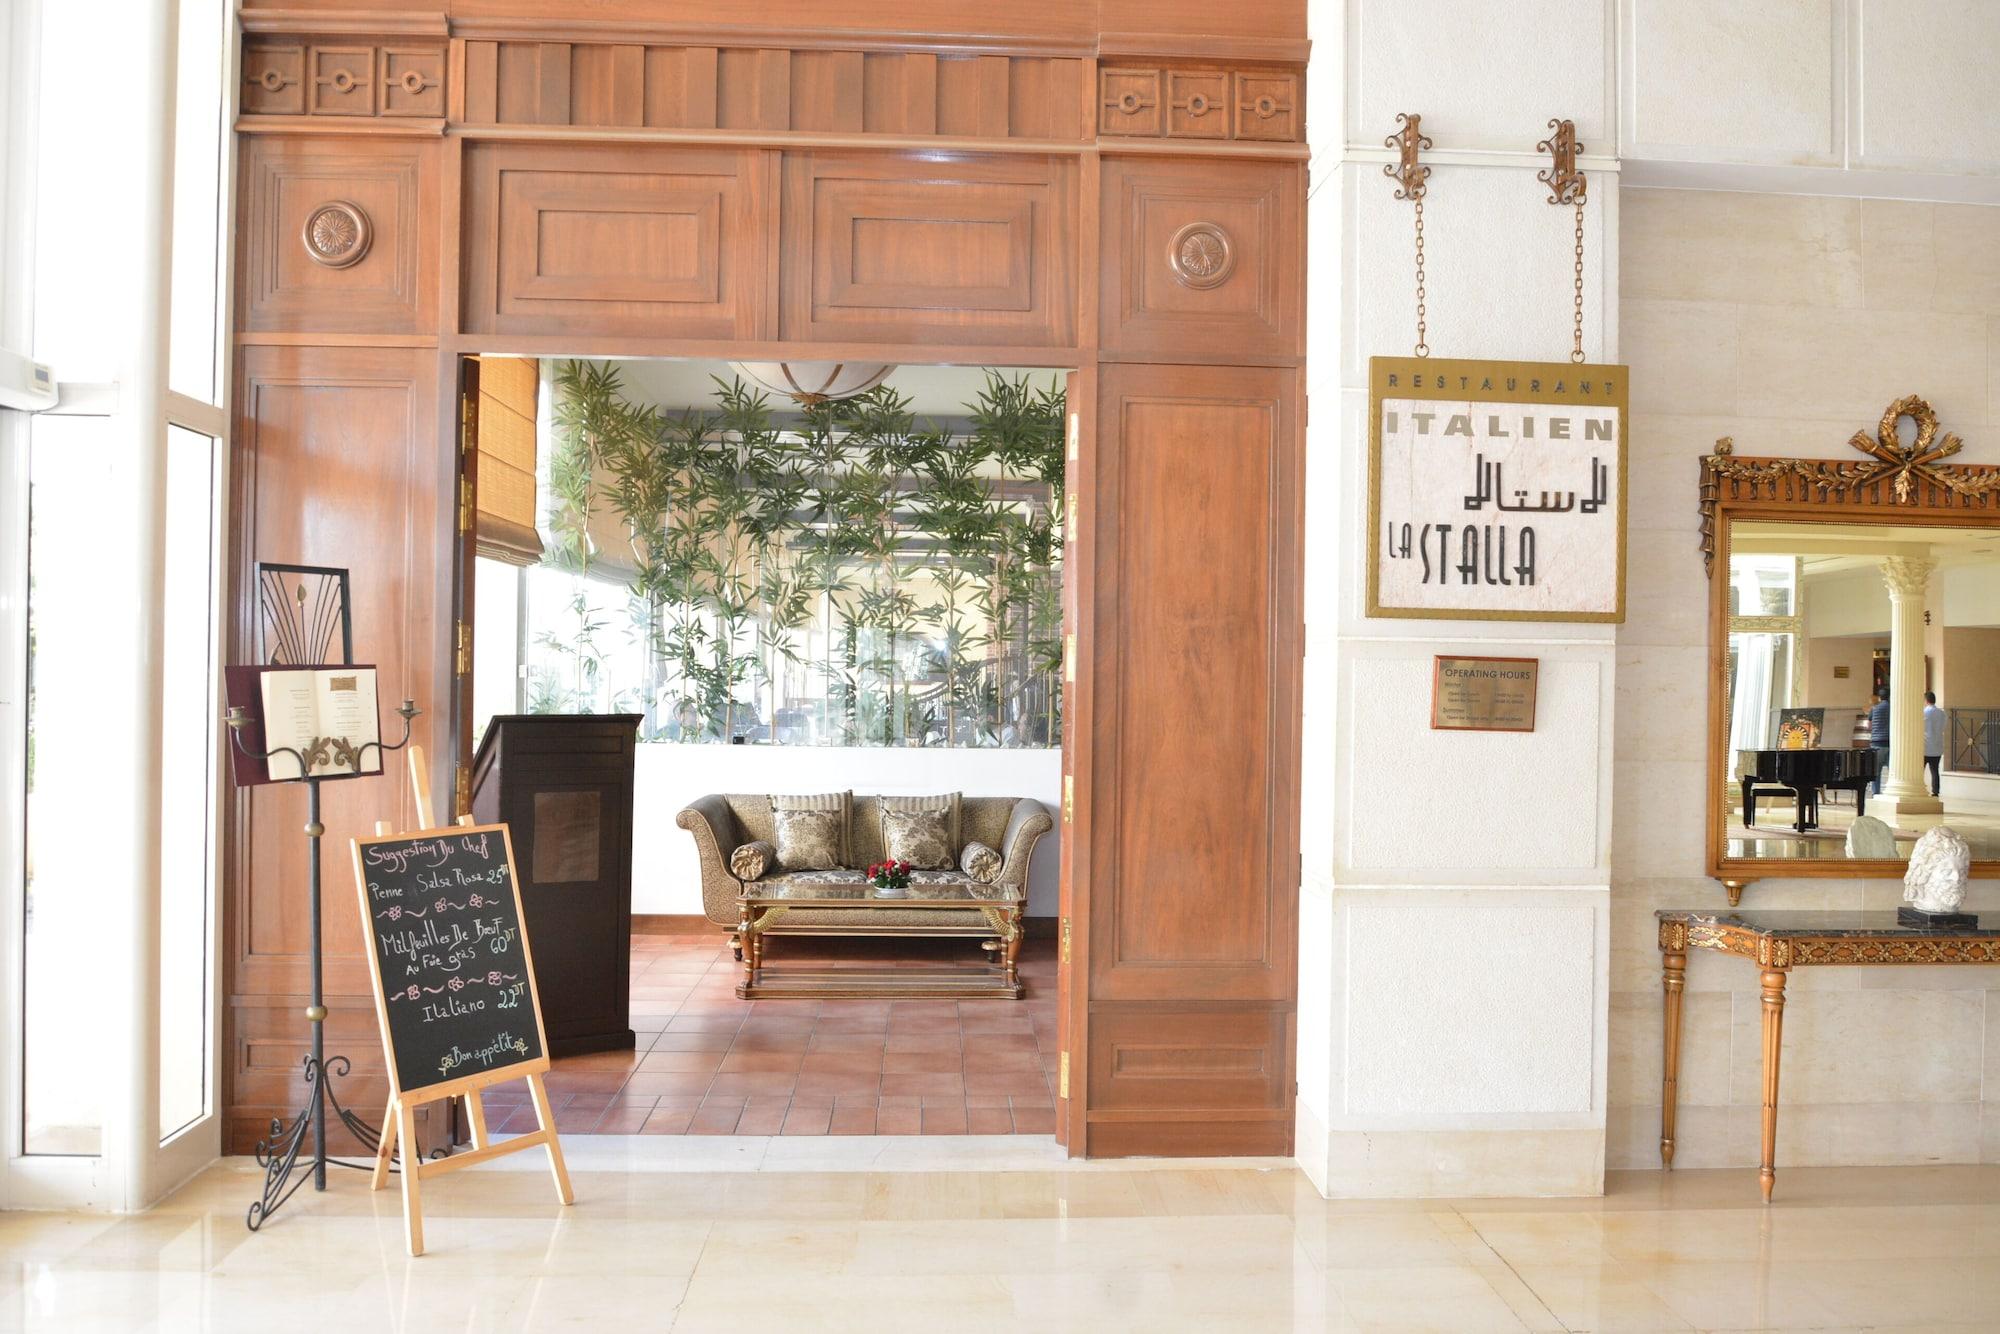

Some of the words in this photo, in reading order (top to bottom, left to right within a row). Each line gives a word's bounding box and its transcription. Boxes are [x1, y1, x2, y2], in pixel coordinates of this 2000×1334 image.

[1389, 374, 1613, 394] RESTAURANT
[1386, 412, 1613, 441] ITALIEN
[1388, 522, 1412, 559] LA
[1419, 523, 1535, 586] STALLA
[1445, 669, 1497, 678] OPERATING
[1500, 671, 1531, 679] HOURS
[366, 840, 437, 873] Suggestion
[426, 839, 454, 867] Du
[461, 834, 489, 859] Chef
[368, 882, 404, 900] Penne
[416, 871, 453, 892] Salsa
[452, 868, 483, 886] Rosa
[448, 924, 469, 951] De
[406, 965, 419, 976] Au
[422, 954, 442, 968] Foie
[440, 947, 476, 971] gras
[451, 1045, 472, 1067] Bon
